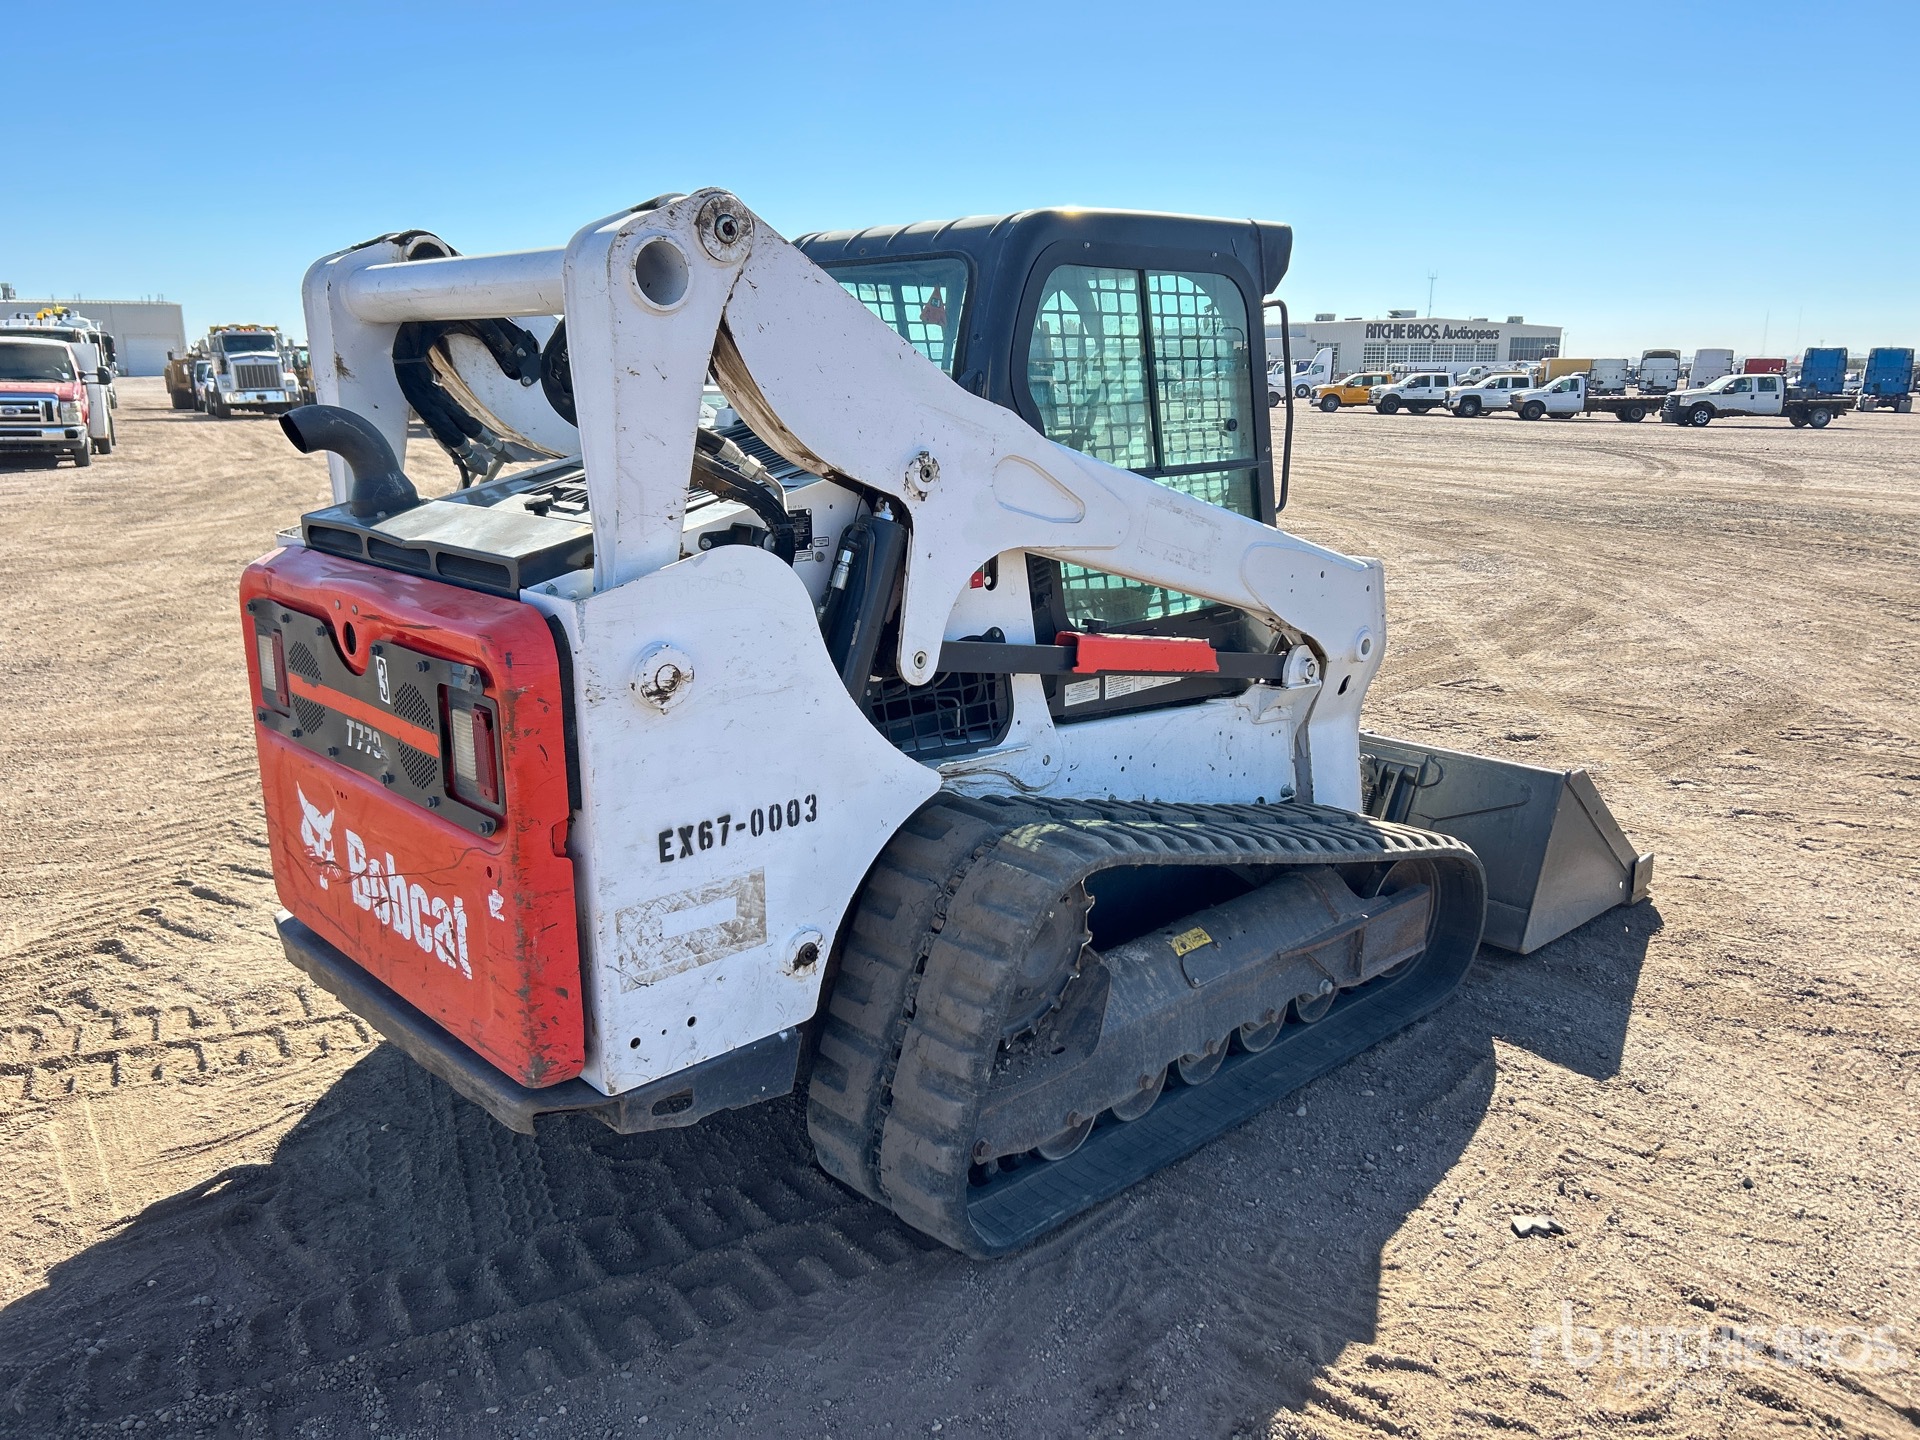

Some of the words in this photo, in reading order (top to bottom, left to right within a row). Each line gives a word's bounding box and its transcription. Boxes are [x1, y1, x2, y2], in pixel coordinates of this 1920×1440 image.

[1365, 323, 1406, 339] RITCHIE
[1407, 323, 1440, 339] BROS.
[1442, 324, 1500, 340] Auctioneers
[377, 658, 390, 702] 3
[658, 794, 818, 863] EX67-0003
[345, 828, 473, 980] Bobcat
